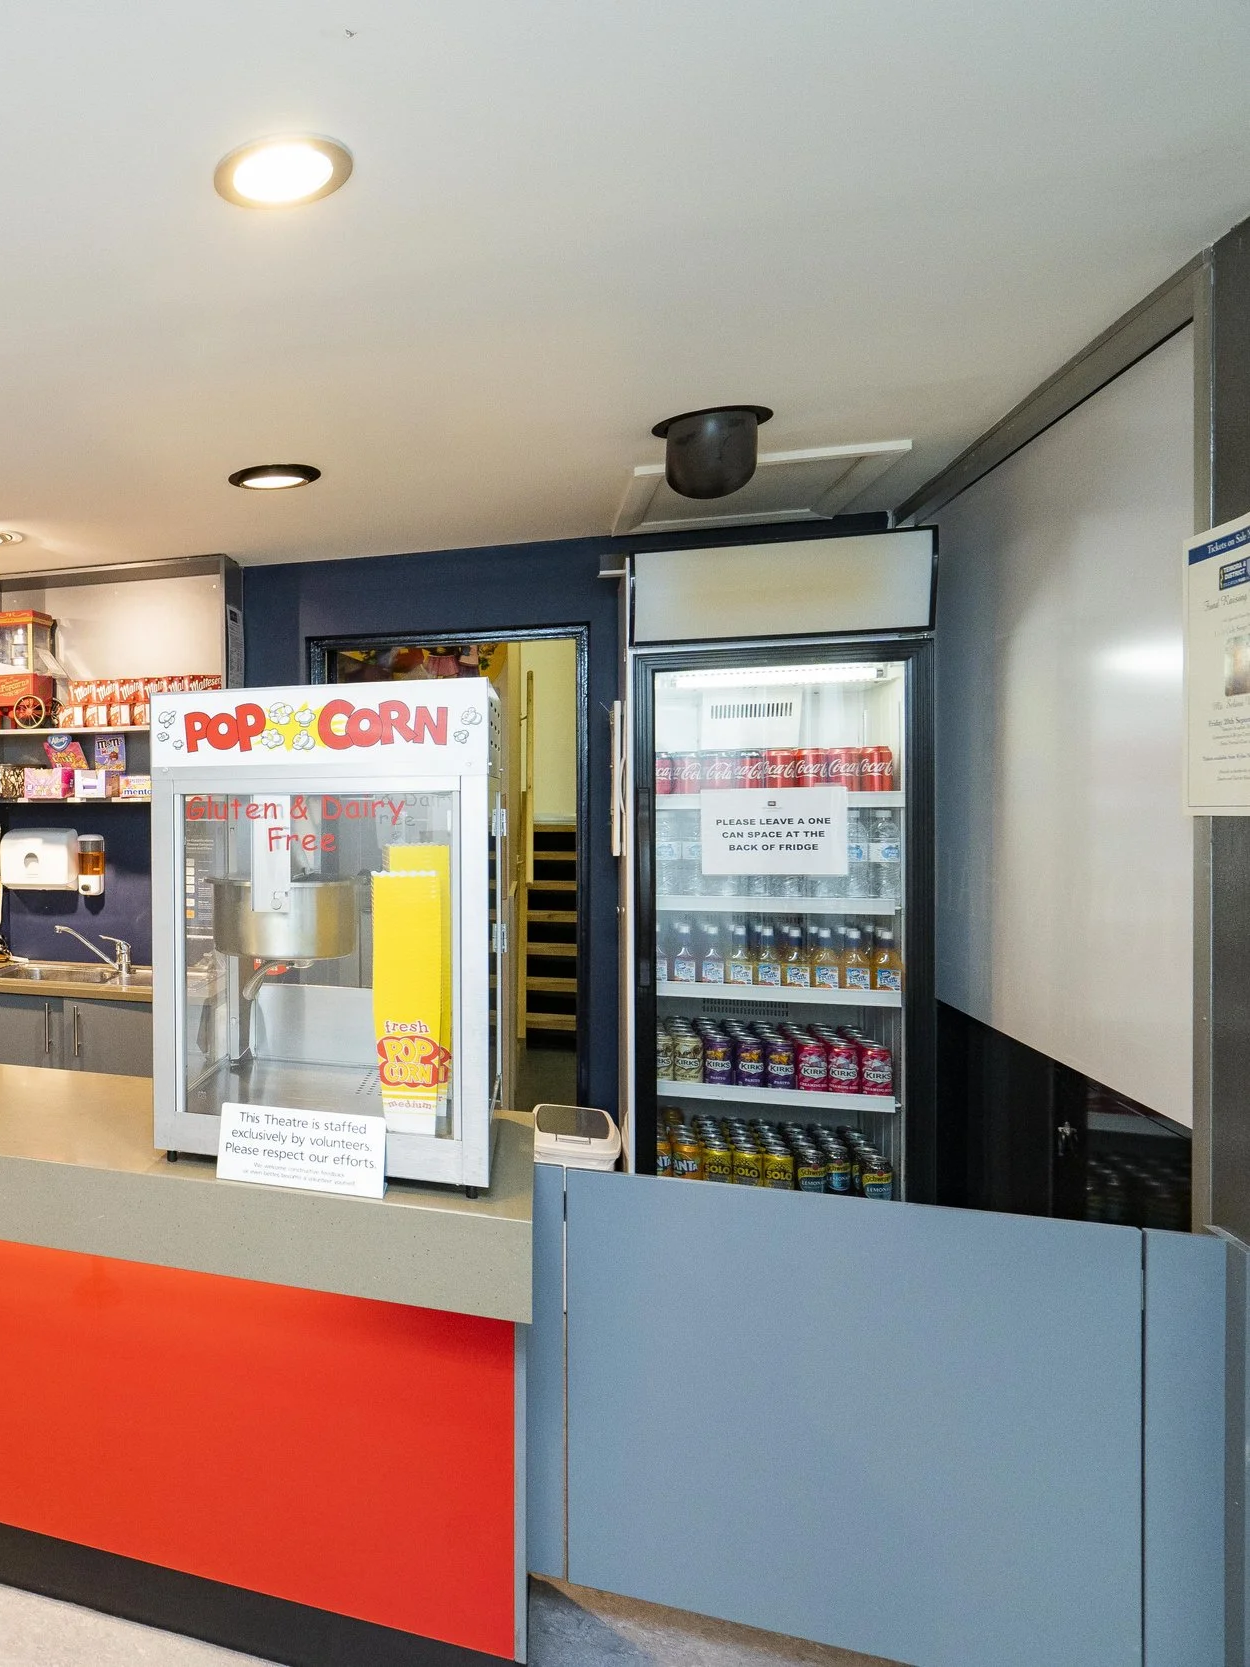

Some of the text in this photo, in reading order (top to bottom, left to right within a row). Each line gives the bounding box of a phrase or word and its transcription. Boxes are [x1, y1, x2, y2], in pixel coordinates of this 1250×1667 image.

[1207, 542, 1227, 554] Tickets
[1235, 531, 1247, 543] Sale
[184, 699, 448, 753] POP CORN
[185, 794, 278, 821] Gluten
[290, 796, 308, 820] &
[322, 795, 406, 826] Dairy
[716, 818, 756, 826] PLEASE
[808, 817, 831, 825] ONE
[268, 827, 337, 852] Free
[722, 831, 743, 839] CAN
[779, 843, 819, 851] FRIDGE
[385, 1020, 429, 1033] fresh
[383, 1037, 433, 1063] POP
[676, 1059, 699, 1067] KIRKS
[706, 1060, 730, 1069] KIRKS
[741, 1062, 763, 1071] KIRKS
[384, 1062, 433, 1084] CORN
[770, 1065, 794, 1073] KIRKS
[803, 1068, 827, 1076] KIRKS
[831, 1069, 856, 1078] KIRKS
[866, 1071, 892, 1080] KIRKS
[387, 1100, 432, 1110] medium
[239, 1111, 367, 1135] This Theatre is staffed
[231, 1128, 373, 1152] exclusively by volunteers.
[225, 1142, 377, 1169] Please respect our efforts.
[674, 1159, 698, 1172] ANTA
[704, 1164, 730, 1174] SOLO
[766, 1170, 792, 1181] SOLO
